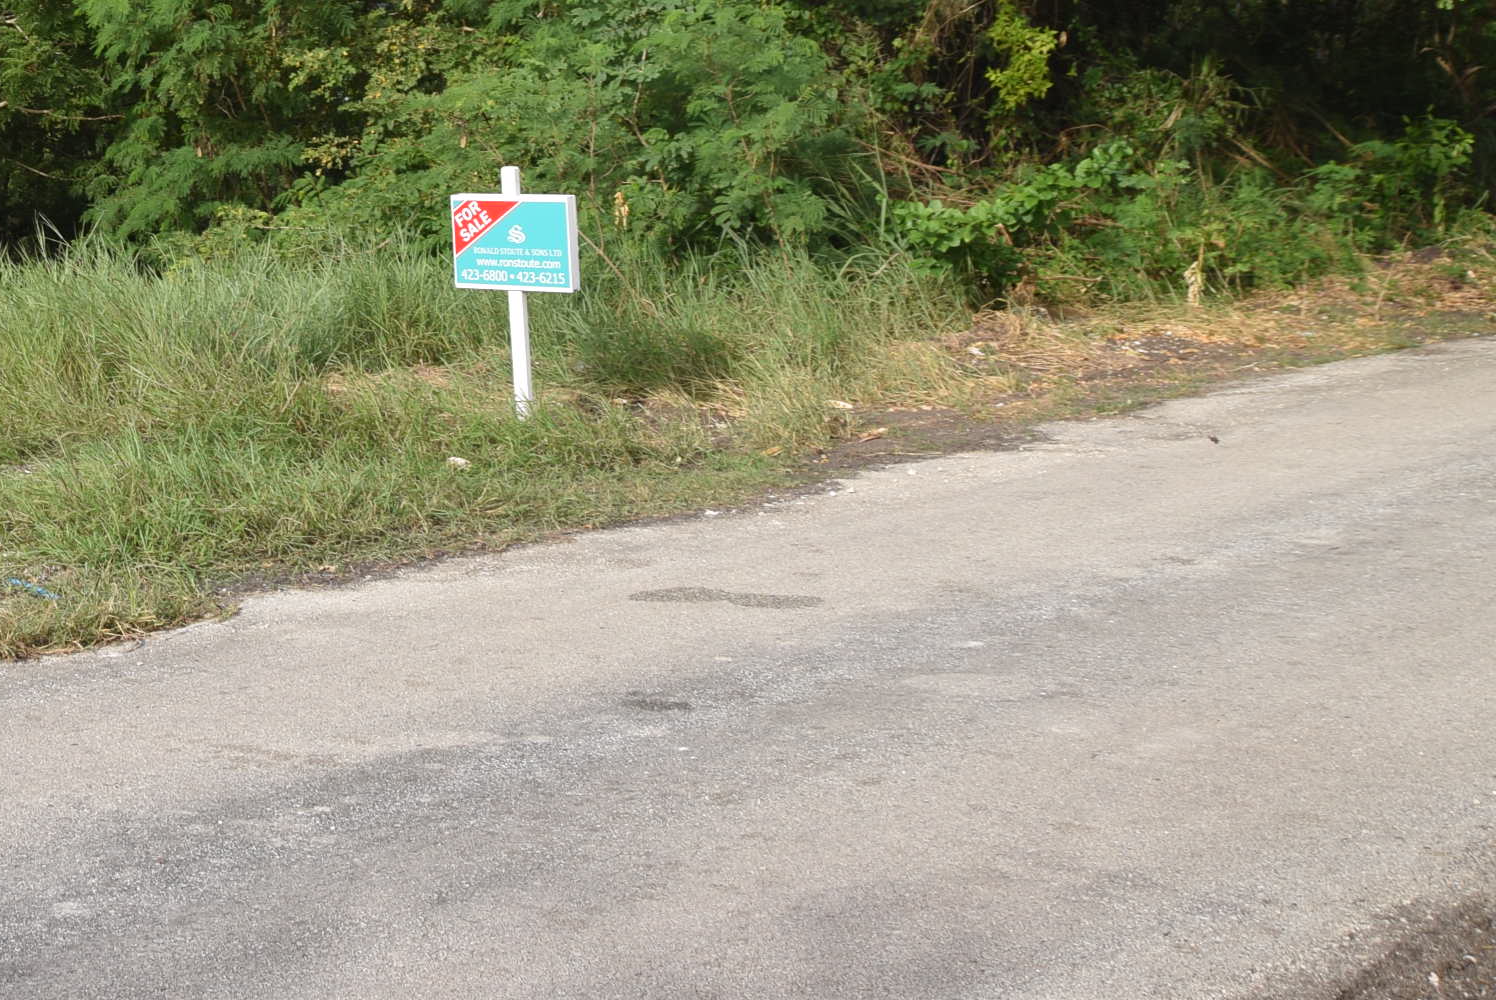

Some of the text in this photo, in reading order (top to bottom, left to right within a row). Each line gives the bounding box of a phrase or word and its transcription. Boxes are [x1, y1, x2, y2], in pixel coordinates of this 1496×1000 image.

[454, 201, 482, 227] FOR
[459, 210, 492, 242] SALE
[461, 269, 566, 284] 423-6800 423-6215
